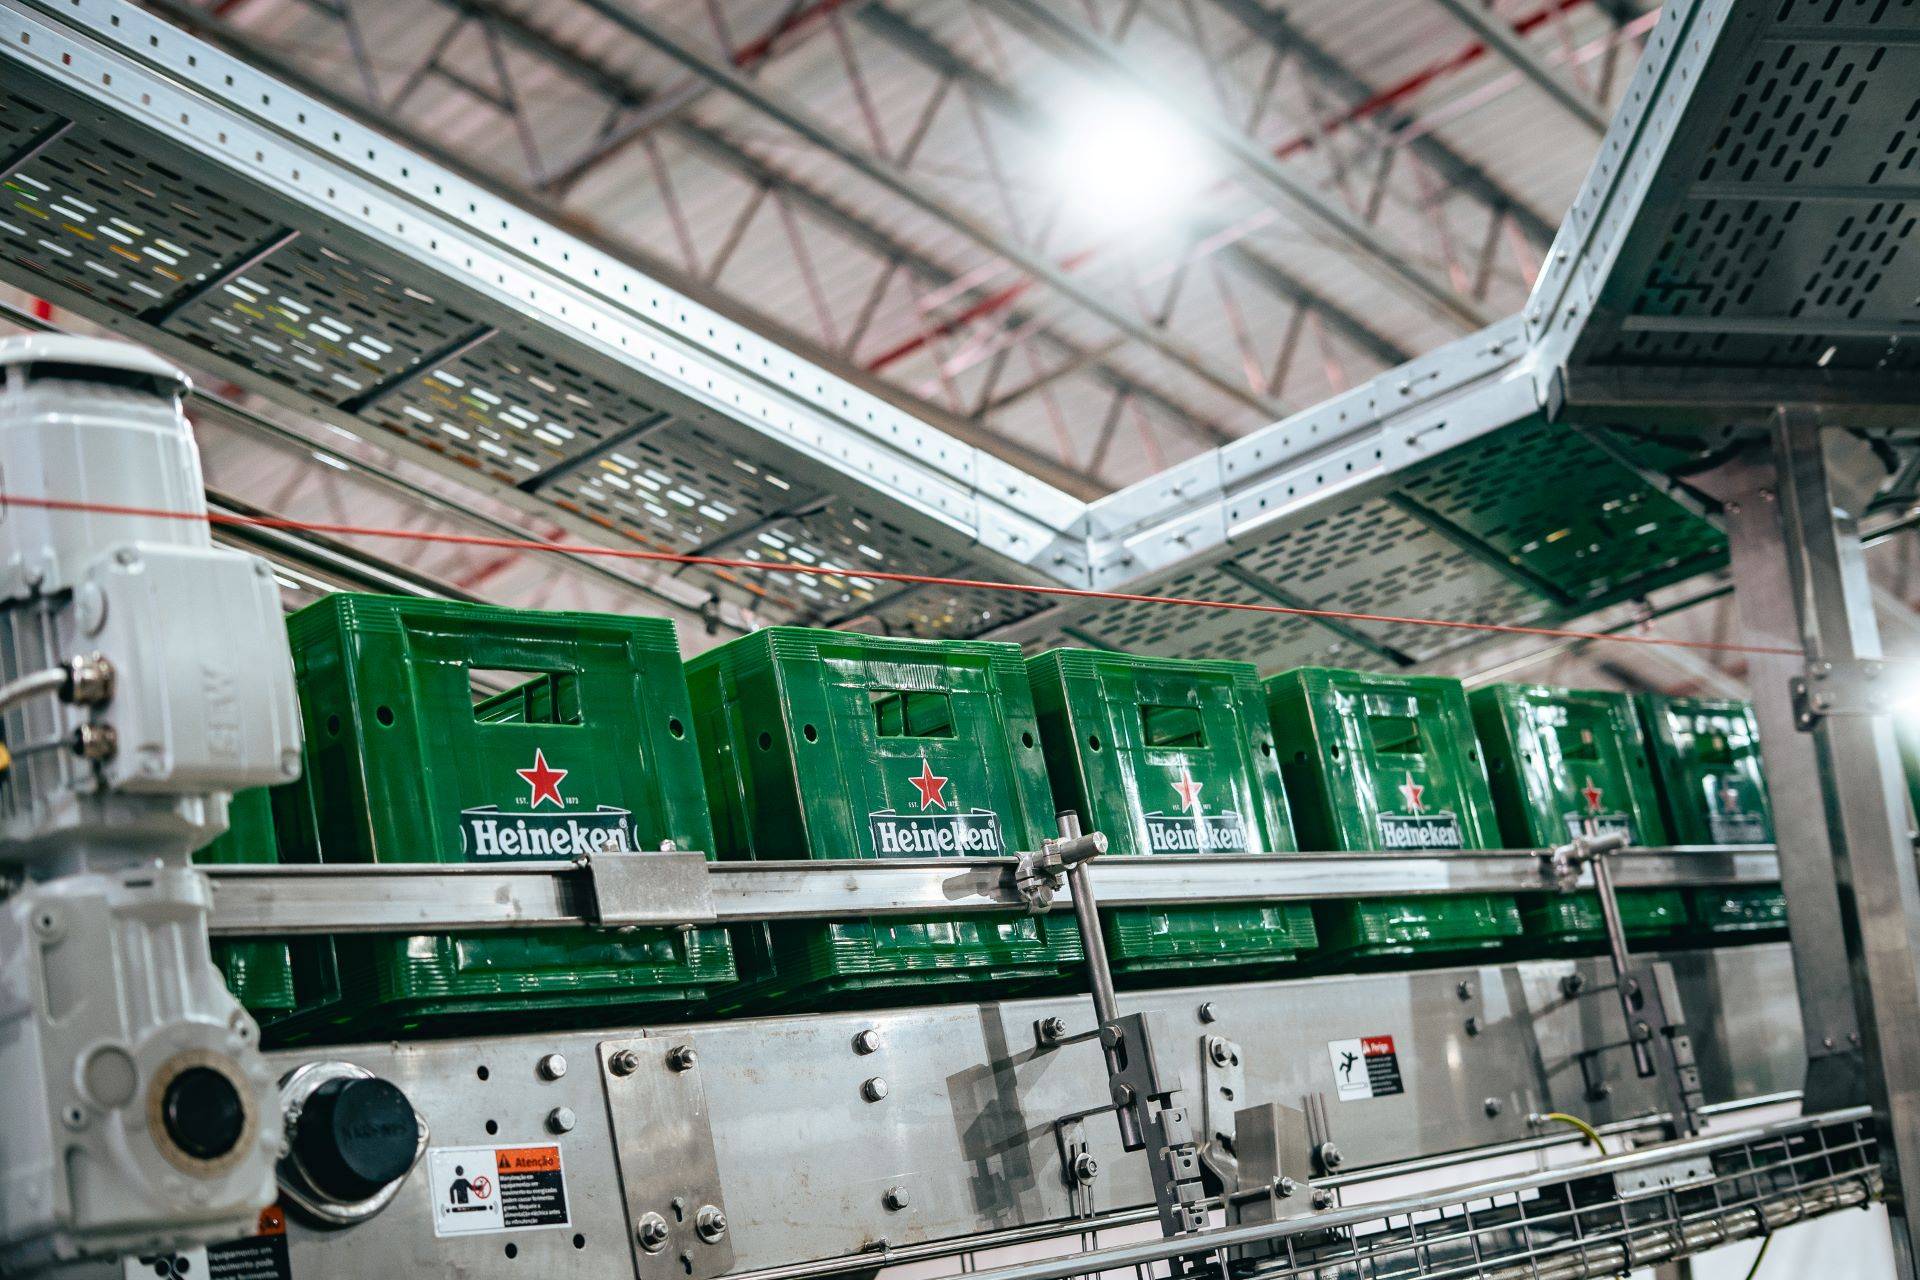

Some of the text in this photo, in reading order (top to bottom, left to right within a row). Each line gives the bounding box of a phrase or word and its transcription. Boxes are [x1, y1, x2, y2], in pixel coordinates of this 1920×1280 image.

[471, 819, 629, 856] Heineken
[878, 821, 998, 853] Heineken
[1382, 821, 1460, 848] Heineken
[515, 1155, 554, 1168] Atenção
